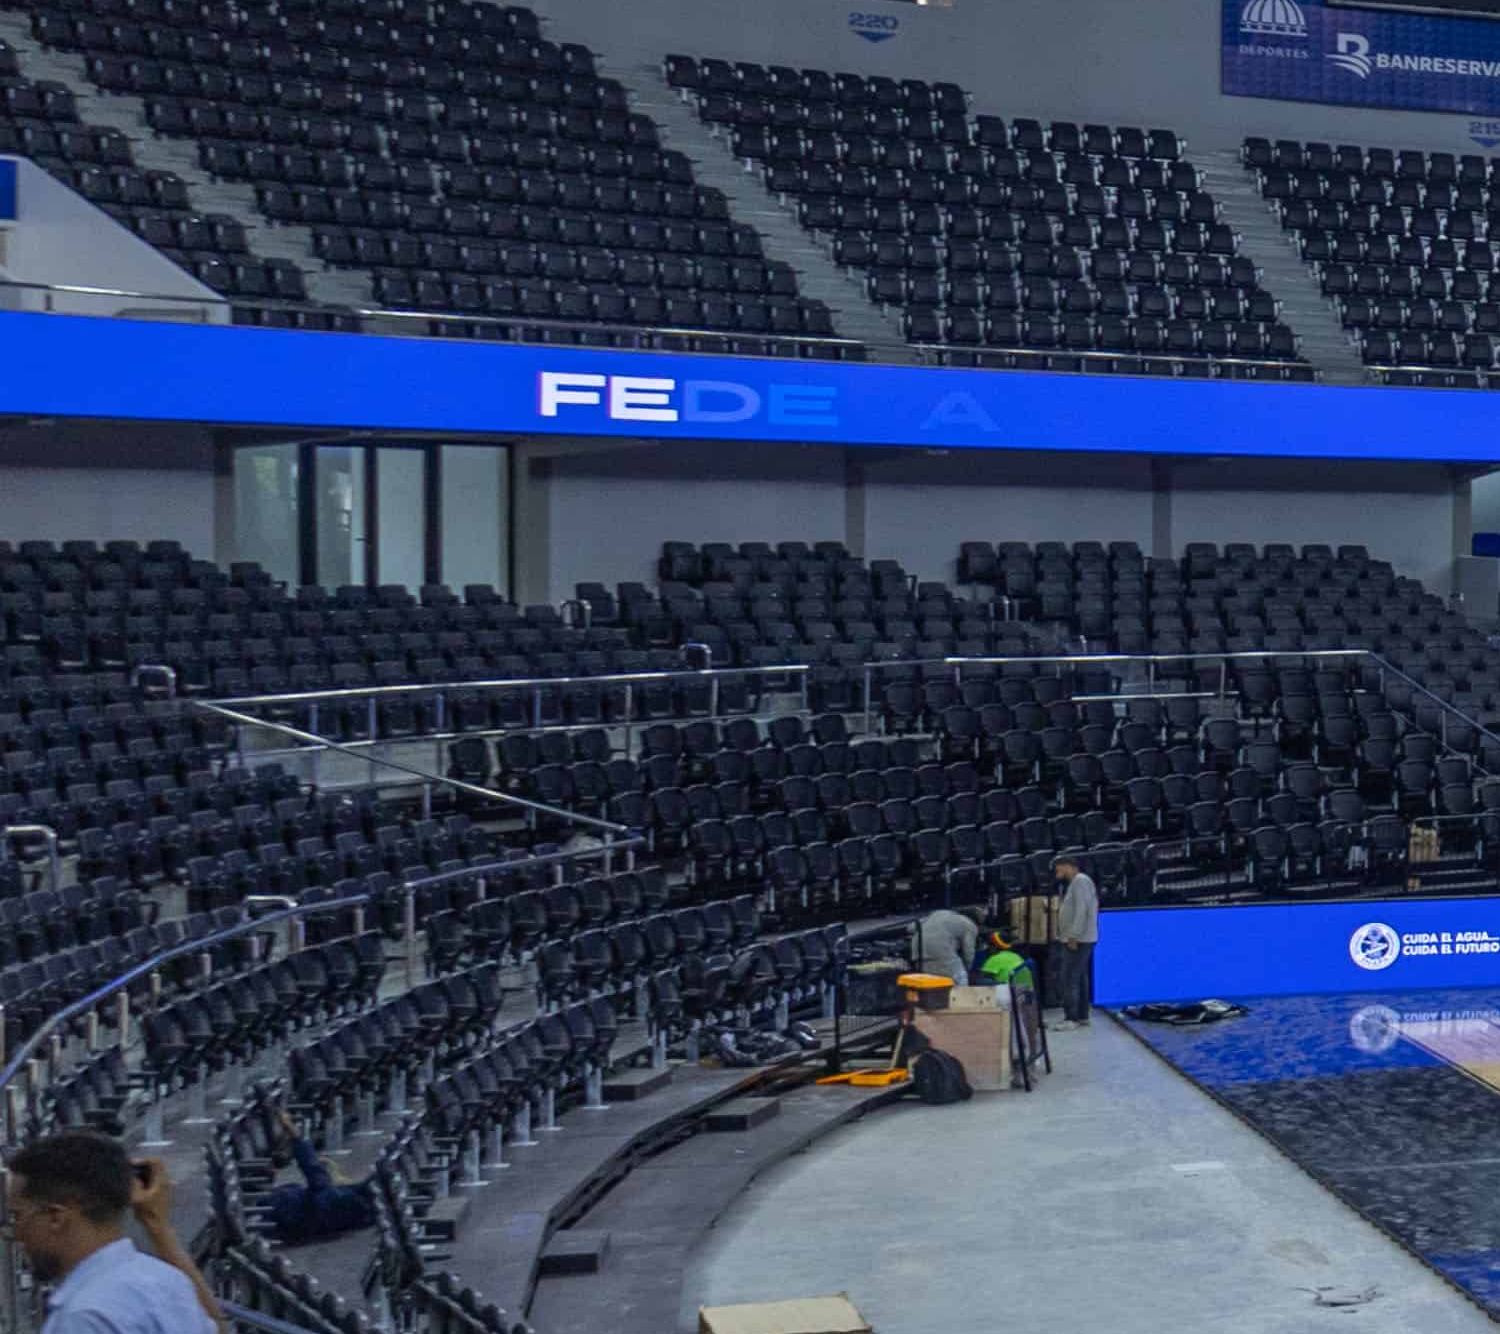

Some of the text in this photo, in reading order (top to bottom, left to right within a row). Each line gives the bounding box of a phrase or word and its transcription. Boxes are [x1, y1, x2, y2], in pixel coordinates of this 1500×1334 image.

[848, 12, 898, 29] 220
[1239, 44, 1310, 59] DEPORTES
[1401, 932, 1439, 944] CUIDA
[1440, 931, 1453, 943] EL
[1401, 942, 1500, 956] CUIDA EL FUTURO
